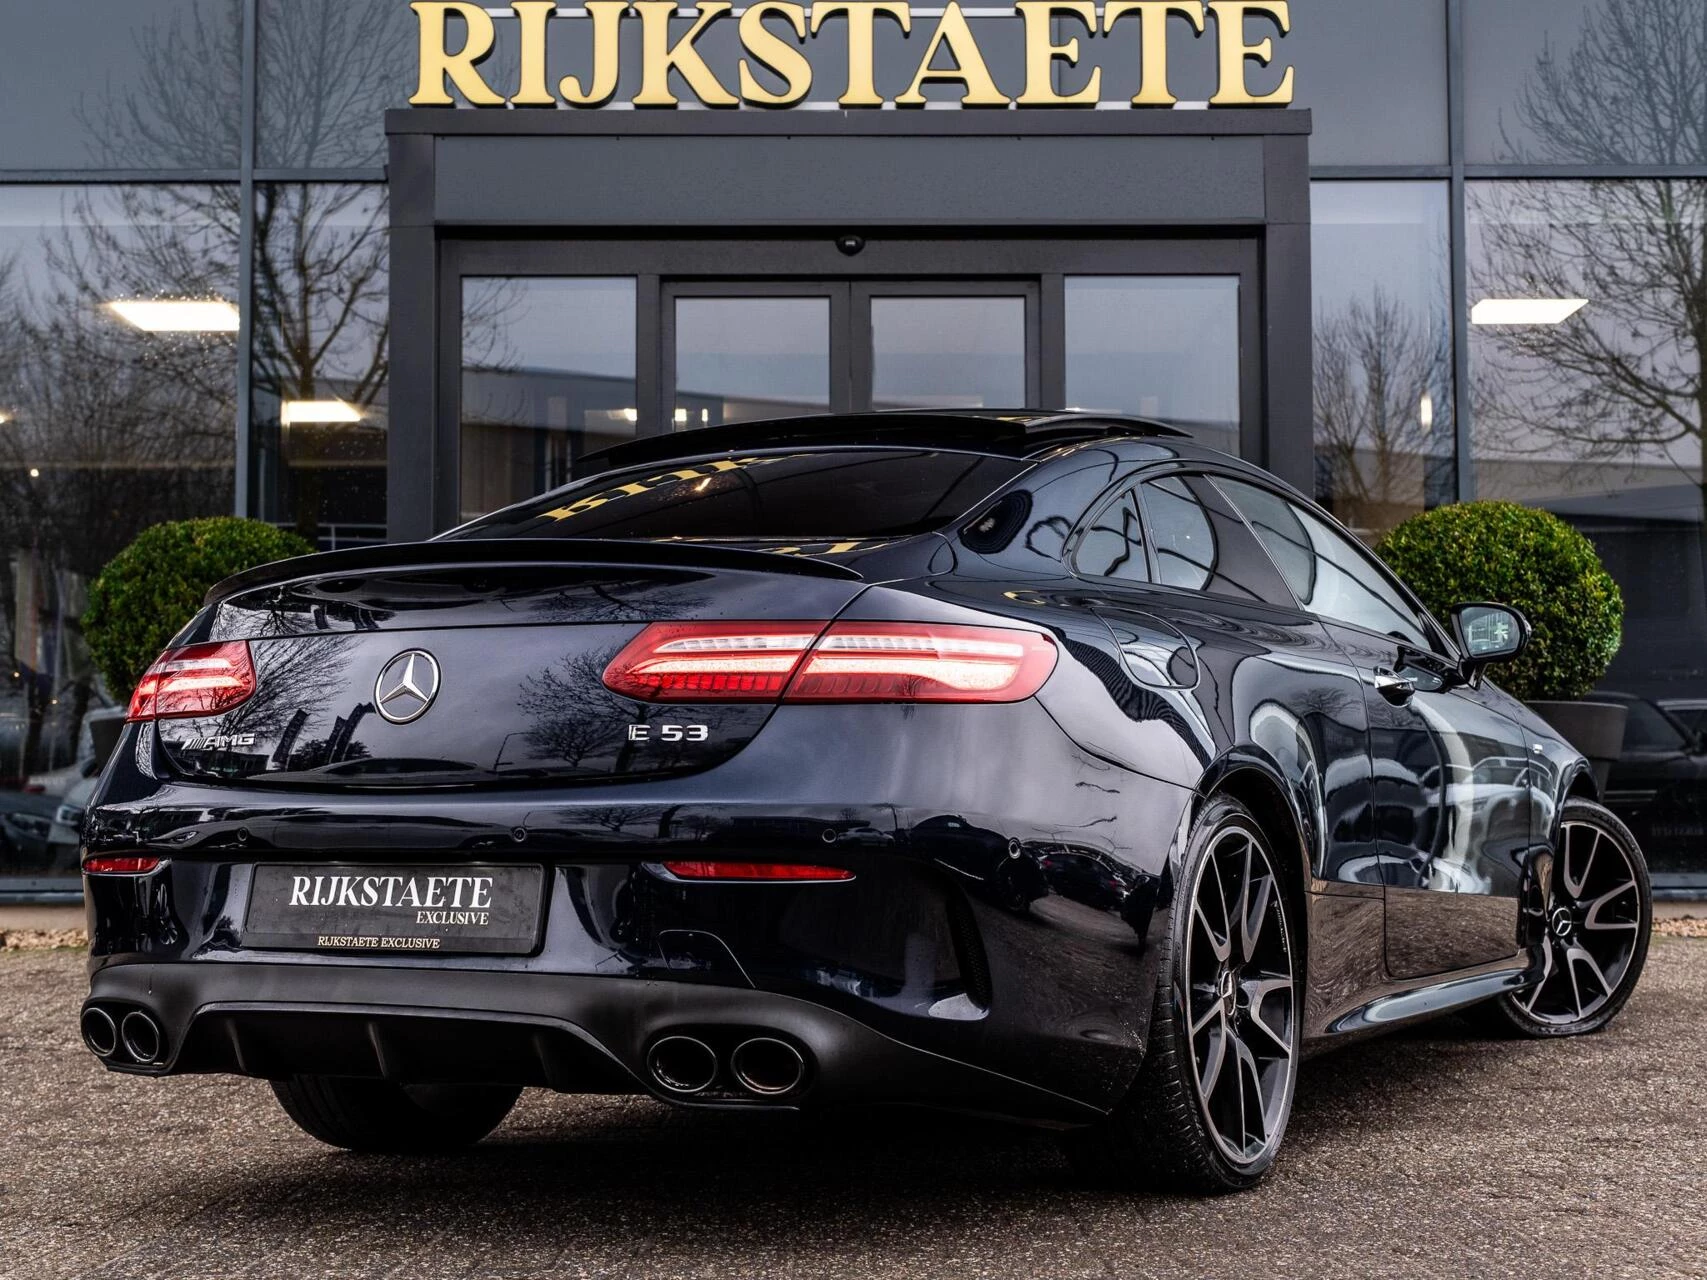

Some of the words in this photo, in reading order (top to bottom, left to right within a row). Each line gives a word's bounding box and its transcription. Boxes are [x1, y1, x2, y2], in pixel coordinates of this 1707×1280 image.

[409, 0, 1294, 108] RIJKSTAETE
[199, 733, 256, 750] AMG
[628, 724, 651, 741] E
[661, 724, 709, 742] 53
[289, 876, 494, 908] RIJKSTAETE
[416, 911, 490, 926] EXCLUSIVE
[317, 936, 379, 948] RIJKSTAETE
[381, 937, 441, 949] EXCLUSIVE
